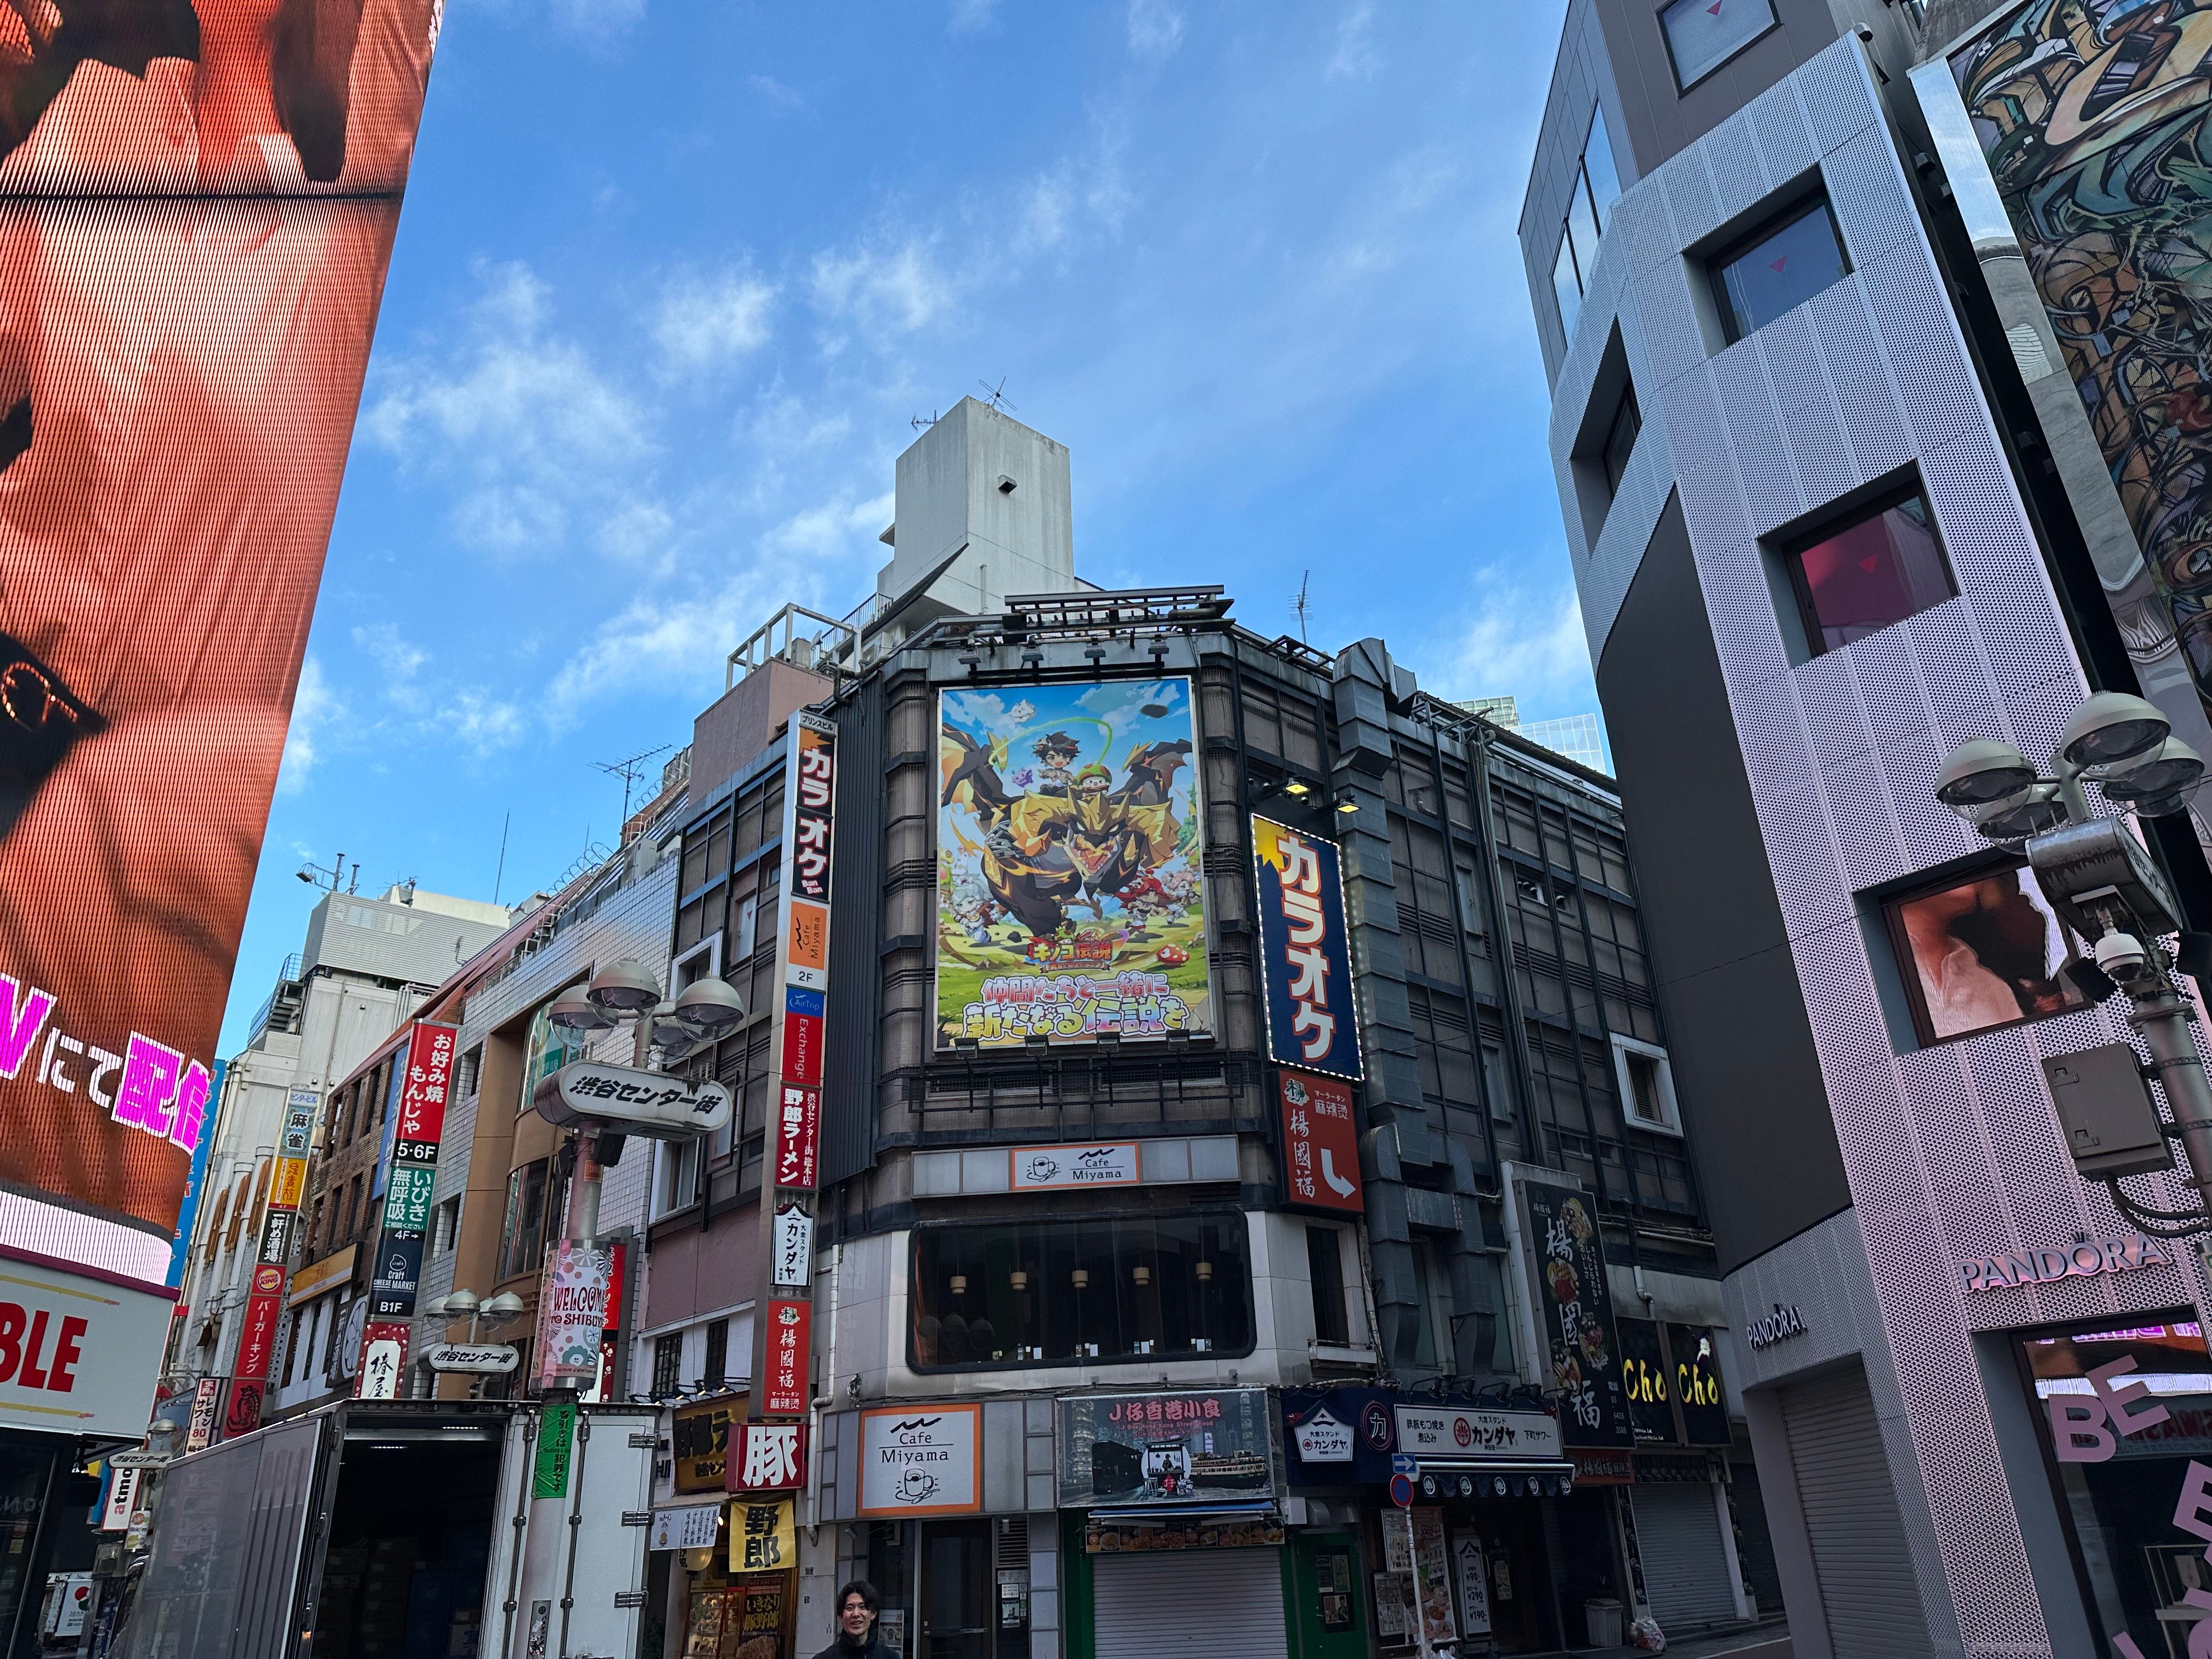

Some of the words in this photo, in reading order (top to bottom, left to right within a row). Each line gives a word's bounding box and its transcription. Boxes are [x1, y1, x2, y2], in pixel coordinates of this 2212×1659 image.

[803, 715, 833, 731] プリンスビル
[799, 748, 831, 877] カラオケ
[802, 879, 817, 888] Ban
[807, 885, 823, 894] Ban
[811, 917, 820, 959] Miyama
[1034, 942, 1113, 962] キノコ伝説
[1277, 834, 1334, 1060] カラオケ
[799, 970, 813, 982] 2F
[983, 973, 1169, 1004] 仲間たちと一緒に
[794, 998, 820, 1011] AirTrip
[966, 996, 1189, 1039] 新たなる伝説を
[795, 1018, 809, 1079] Exchange
[425, 1034, 452, 1103] お好み焼
[290, 1093, 317, 1103] センタービル
[405, 1065, 426, 1134] もんじゃ
[569, 1076, 723, 1114] 渋谷センター街
[1315, 1090, 1345, 1102] マーラータン
[288, 1114, 307, 1149] 麻雀
[780, 1088, 803, 1183] 野郎ラーメン
[1085, 1158, 1109, 1167] Cafe
[1290, 1109, 1315, 1198] 楊國福
[283, 1163, 298, 1201] 鳥貴族
[1073, 1170, 1122, 1181] Miyama
[387, 1169, 411, 1221] 無呼吸
[409, 1171, 430, 1222] いびき
[264, 1213, 286, 1263] 一軒め酒場
[394, 1231, 410, 1240] 4F
[785, 1224, 798, 1280] カンダヤ
[1956, 1233, 2172, 1291] PANDORA
[260, 1273, 279, 1282] BURGER
[261, 1277, 279, 1286] KING
[388, 1270, 405, 1280] Craft
[392, 1280, 416, 1291] MARKET
[380, 1302, 403, 1313] B1F
[246, 1300, 269, 1374] バーガーキング
[1747, 1306, 1801, 1348] PANDORA
[435, 1350, 514, 1364] 渋谷センター街
[778, 1329, 797, 1389] 楊國福
[370, 1352, 393, 1398] 椿屋
[1623, 1359, 1667, 1403] Cho
[1678, 1363, 1719, 1406] Cho
[194, 1399, 205, 1427] サワー
[202, 1397, 215, 1425] レモン
[1407, 1419, 1444, 1430] 鉄板もつ焼き
[899, 1432, 932, 1444] Cafe
[1313, 1440, 1347, 1449] カンダヤ
[1418, 1432, 1436, 1443] 煮込み
[1472, 1426, 1515, 1445] カンダヤ
[1524, 1430, 1551, 1440] 下町サワー
[742, 1426, 798, 1487] 豚
[881, 1449, 949, 1465] Miyama
[744, 1505, 781, 1568] 野郎
[747, 1594, 781, 1612] いきなり
[1468, 1591, 1483, 1600] ¥290
